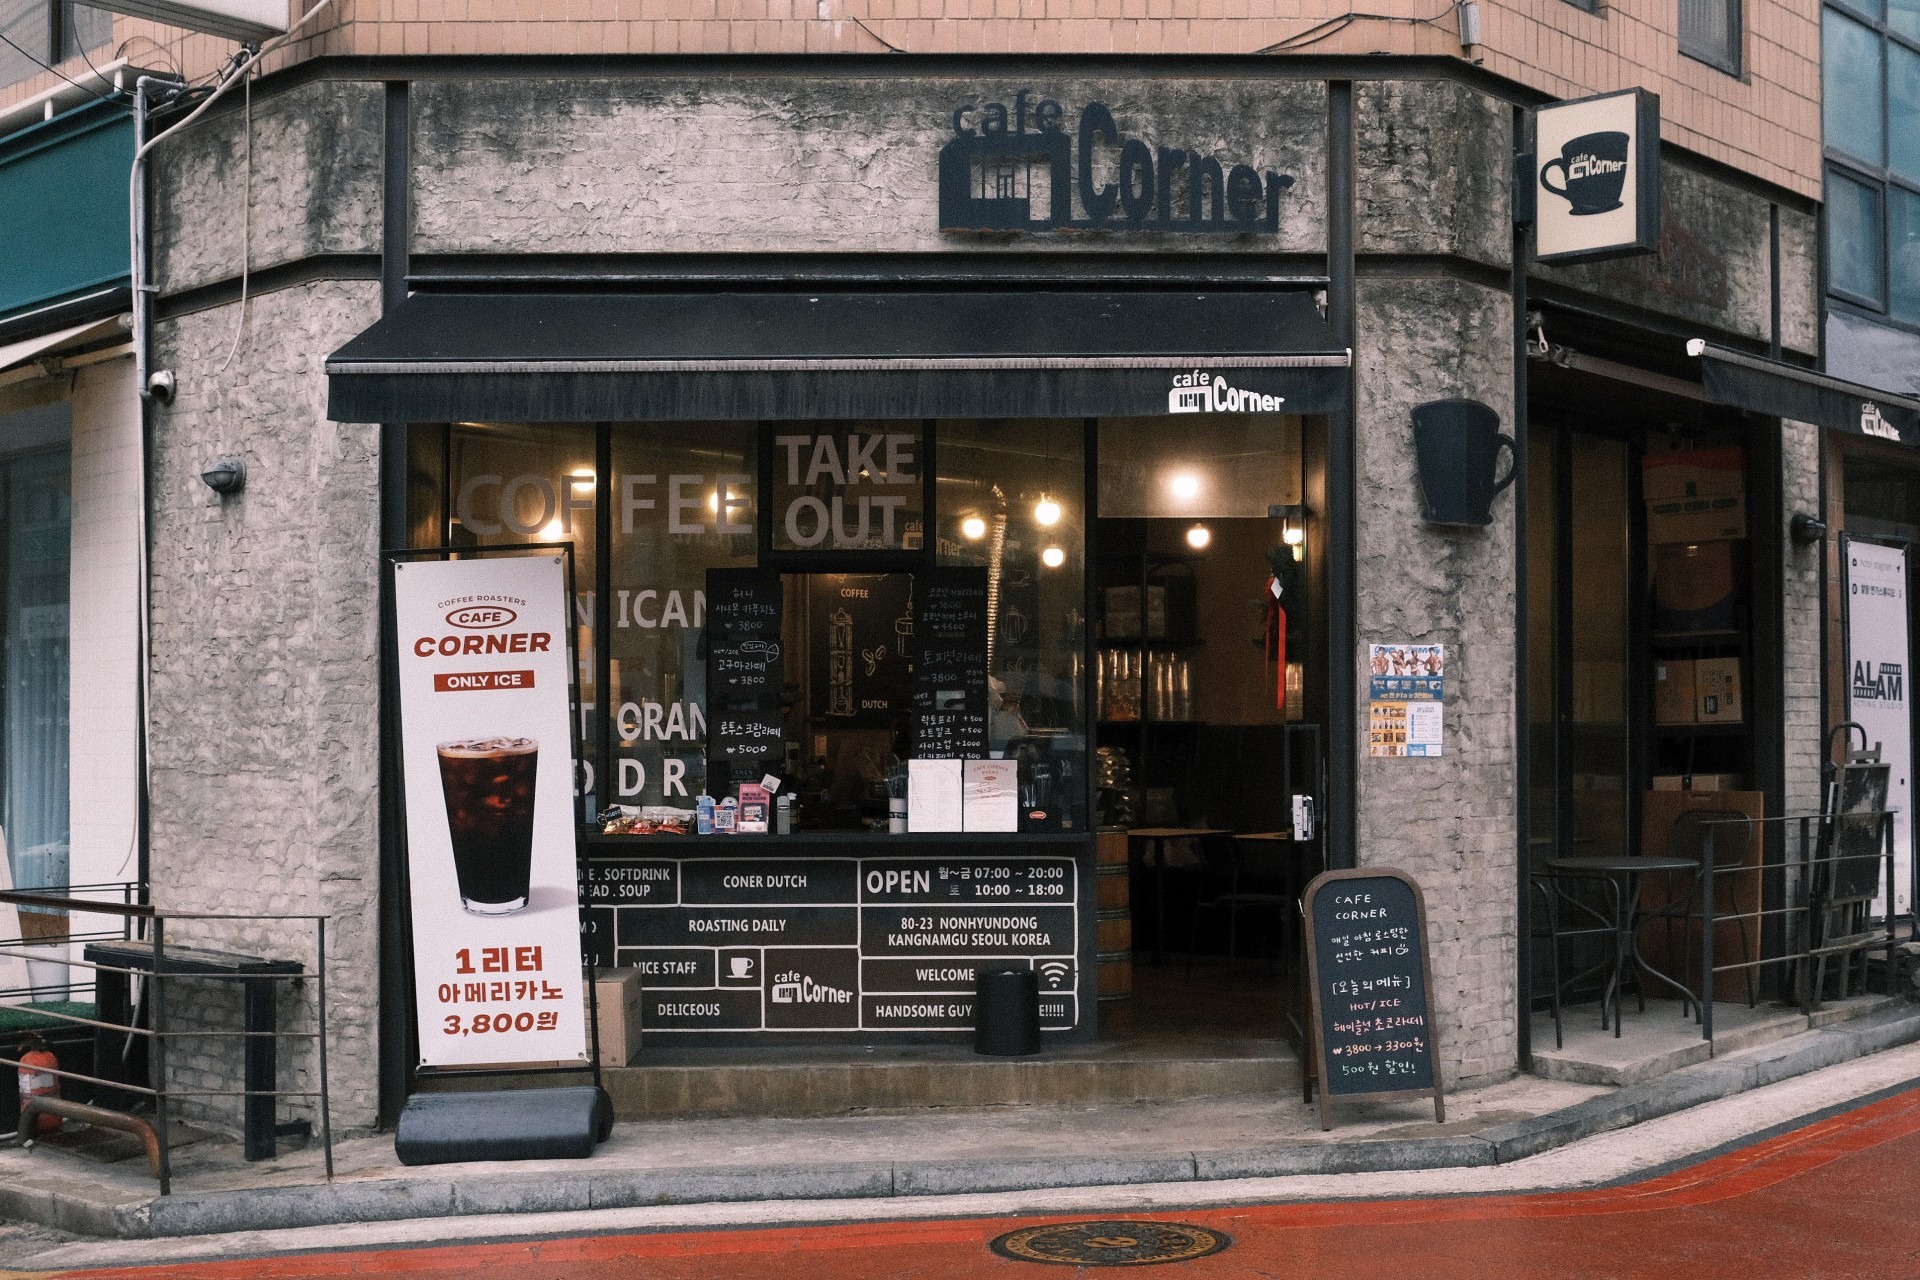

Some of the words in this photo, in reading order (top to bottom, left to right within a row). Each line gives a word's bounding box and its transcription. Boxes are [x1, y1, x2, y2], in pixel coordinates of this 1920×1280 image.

[953, 88, 1062, 138] cafe
[1079, 101, 1294, 228] Corner
[1571, 153, 1588, 163] cafe
[1590, 154, 1624, 175] Corner
[1173, 369, 1209, 387] cafe
[1213, 376, 1285, 412] Corner
[775, 434, 916, 485] TAKE
[457, 474, 752, 535] COFFEE
[785, 495, 906, 547] OUT
[732, 588, 753, 598] 허니
[840, 588, 869, 599] COFFEE
[438, 596, 474, 609] COFFEE
[477, 595, 527, 606] ROASTERS
[716, 603, 739, 616] 시나몬
[742, 603, 776, 615] 카푸치노
[458, 612, 502, 624] CAFE
[413, 632, 551, 658] CORNER
[718, 660, 766, 672] 고구마라떼
[447, 675, 489, 688] ONLY
[494, 674, 522, 686] ICE
[741, 676, 765, 685] 3800
[862, 700, 888, 709] DUTCH
[738, 745, 767, 753] 5000
[604, 868, 671, 881] SOFTDRINK
[974, 867, 1010, 879] 07:00
[1028, 867, 1064, 879] 20:00
[723, 875, 763, 888] CONER
[767, 875, 807, 888] DUTCH
[866, 870, 930, 893] OPEN
[619, 884, 651, 897] SOUP
[975, 884, 1010, 896] 10:00
[1028, 884, 1064, 896] 18:00
[1335, 894, 1371, 905] CAFE
[1335, 908, 1387, 920] CORNER
[689, 919, 749, 932] ROASTING
[752, 919, 786, 932] DAILY
[901, 917, 933, 930] 80-23
[939, 917, 1038, 930] NONHYUNDONG
[888, 933, 969, 946] KANGNAMGU
[971, 933, 1008, 946] SEOUL
[1012, 933, 1051, 946] KOREA
[1331, 935, 1350, 947] 매일
[1354, 932, 1371, 942] 아침
[1375, 927, 1409, 940] 로스팅한
[1335, 950, 1363, 963] 신선한
[1370, 946, 1392, 956] 커피
[633, 961, 659, 974] NICE
[663, 961, 697, 974] STAFF
[774, 970, 800, 983] cafe
[916, 968, 975, 981] WELCOME
[438, 980, 564, 1003] 아메리카노
[803, 975, 853, 1003] Corner
[658, 1003, 720, 1016] DELICEOUS
[876, 1004, 945, 1018] HANDSOME
[948, 1004, 973, 1017] GUY
[443, 1012, 558, 1037] 3,800원
[1333, 1020, 1371, 1035] 헤이즐넛
[1375, 1015, 1424, 1030] 초코라떼
[1345, 1044, 1372, 1056] 3800
[1385, 1037, 1424, 1052] 3300원
[1385, 1060, 1416, 1074] 할인!
